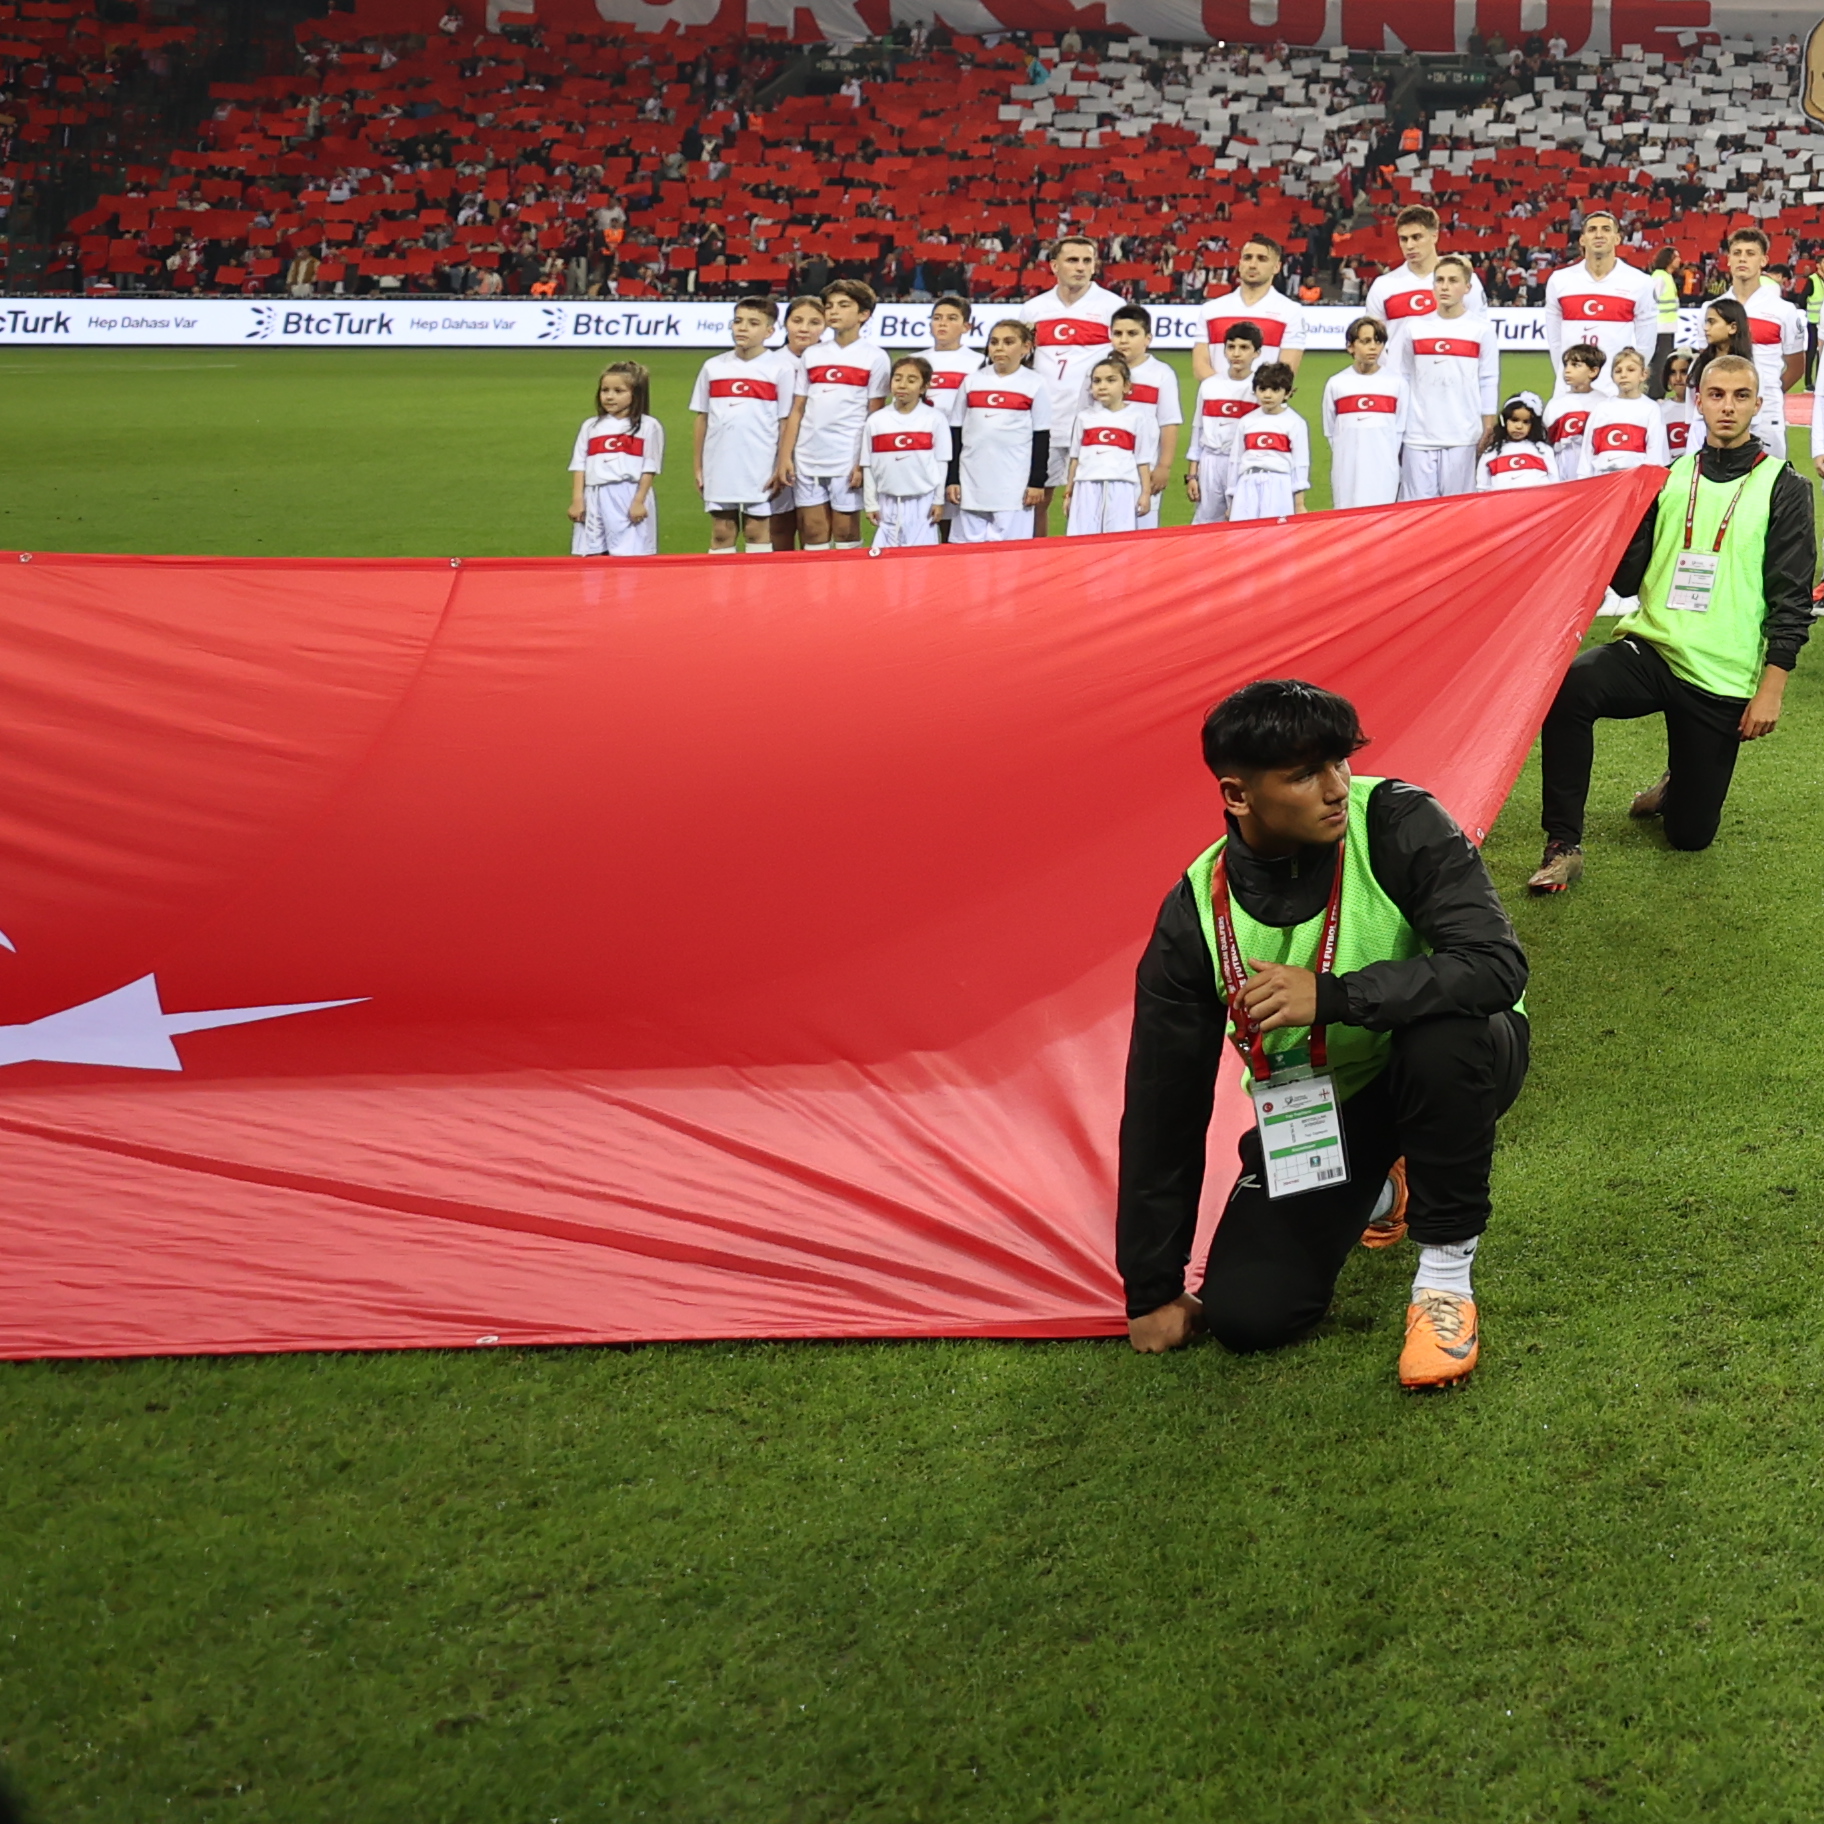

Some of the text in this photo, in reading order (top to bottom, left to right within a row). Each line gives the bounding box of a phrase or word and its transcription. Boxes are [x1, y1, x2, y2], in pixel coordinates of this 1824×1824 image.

[88, 316, 117, 330] Hep
[120, 316, 170, 329] Dahası
[174, 317, 199, 329] Var
[283, 312, 516, 335] BtcTurk Hep Dahası Var
[573, 313, 724, 337] BtcTurk Hep
[1491, 319, 1546, 339] Turk
[1057, 359, 1068, 381] 7
